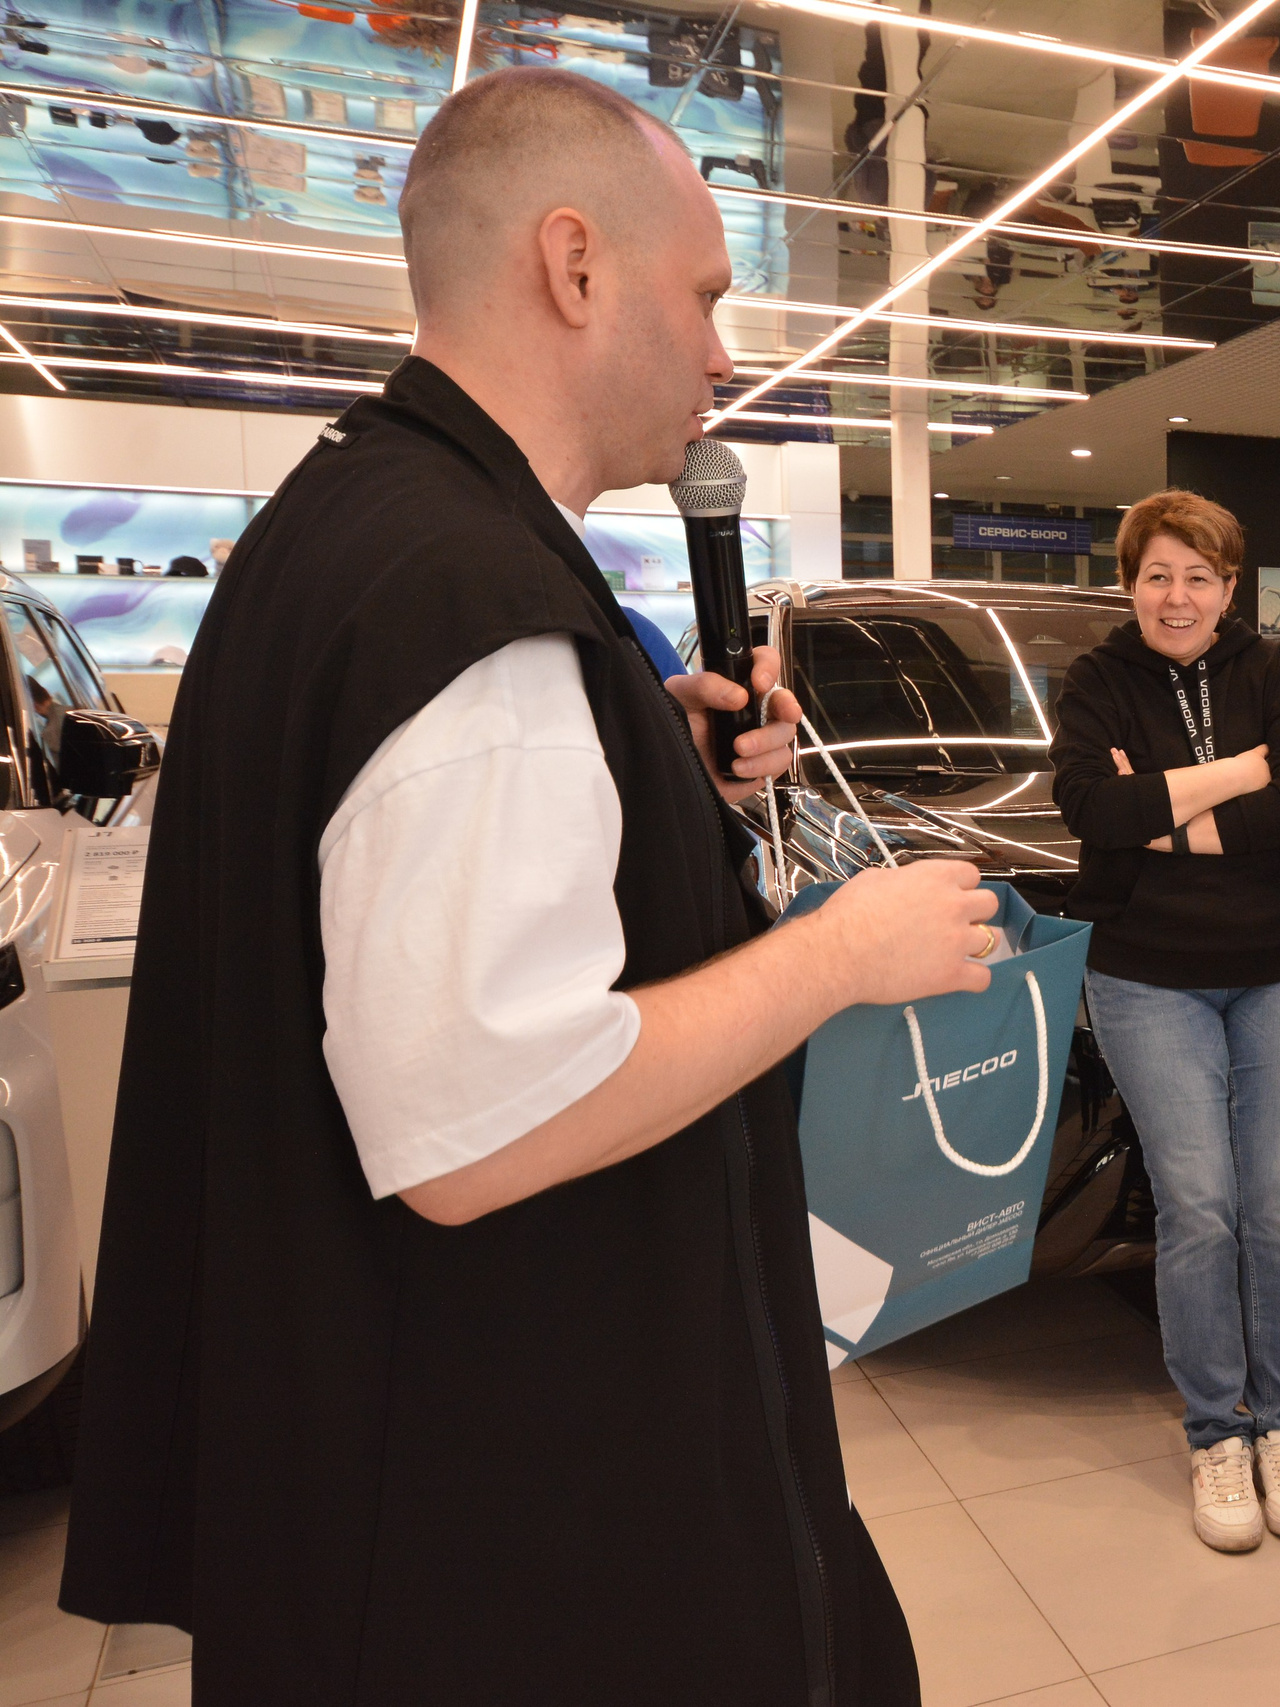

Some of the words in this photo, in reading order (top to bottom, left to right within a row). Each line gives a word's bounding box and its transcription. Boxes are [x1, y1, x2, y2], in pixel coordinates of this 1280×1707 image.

[978, 526, 1068, 541] СЕРВИС-БЮРО
[1176, 689, 1198, 738] OMODA
[1199, 679, 1212, 727] OMODA
[966, 1200, 1025, 1232] ВИСТ-АВТО
